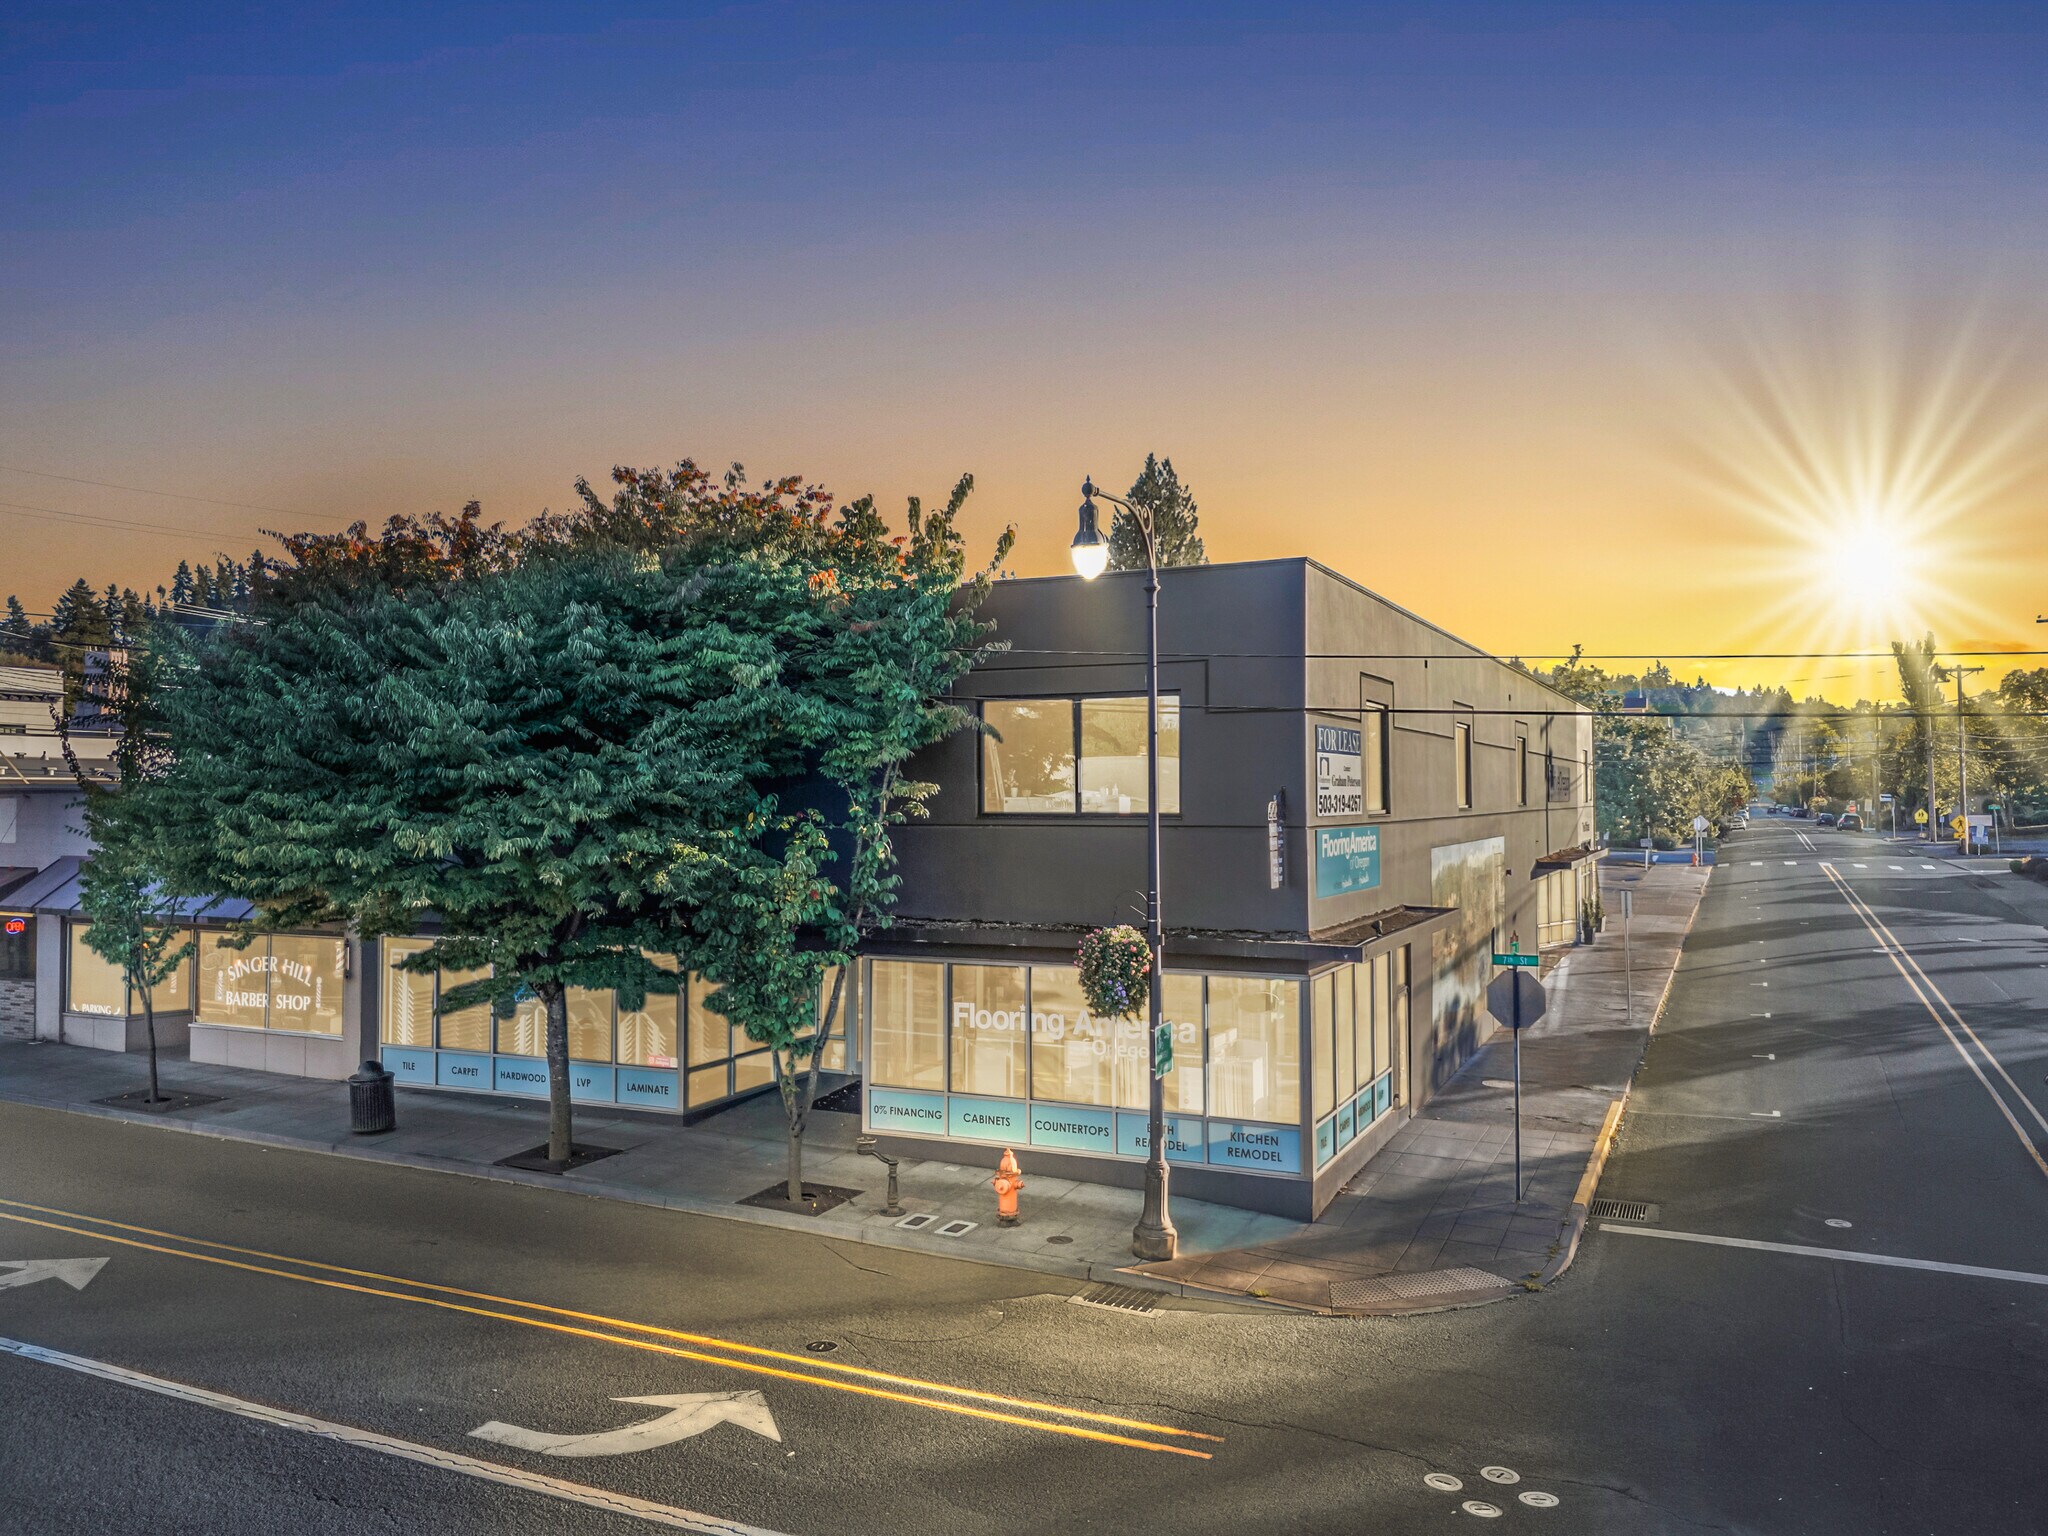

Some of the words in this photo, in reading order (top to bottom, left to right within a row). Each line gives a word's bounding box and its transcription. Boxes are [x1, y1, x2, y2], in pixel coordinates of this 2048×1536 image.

[1318, 728, 1337, 751] FOR
[1338, 730, 1360, 753] LEASE
[1322, 832, 1350, 860] Flooring
[1350, 830, 1376, 853] America
[5, 921, 25, 932] OPEN
[1520, 956, 1528, 966] St
[227, 956, 278, 982] SINGER
[282, 958, 311, 987] HILL
[225, 990, 269, 1008] BARBER
[276, 994, 311, 1011] SHOP
[81, 1003, 112, 1015] PARKING
[953, 1002, 1064, 1040] Flooring
[402, 1061, 416, 1071] TILE
[451, 1066, 479, 1077] CARPET
[500, 1071, 547, 1083] HARDWOOD
[576, 1077, 592, 1088] LVP
[626, 1082, 669, 1096] LAMINATE
[873, 1104, 888, 1116] 0%
[889, 1106, 943, 1120] FINANCING
[963, 1112, 1011, 1127] CABINETS
[1034, 1120, 1110, 1138] COUNTERTOPS
[1230, 1131, 1279, 1147] KITCHEN
[1227, 1146, 1283, 1163] REMODEL
